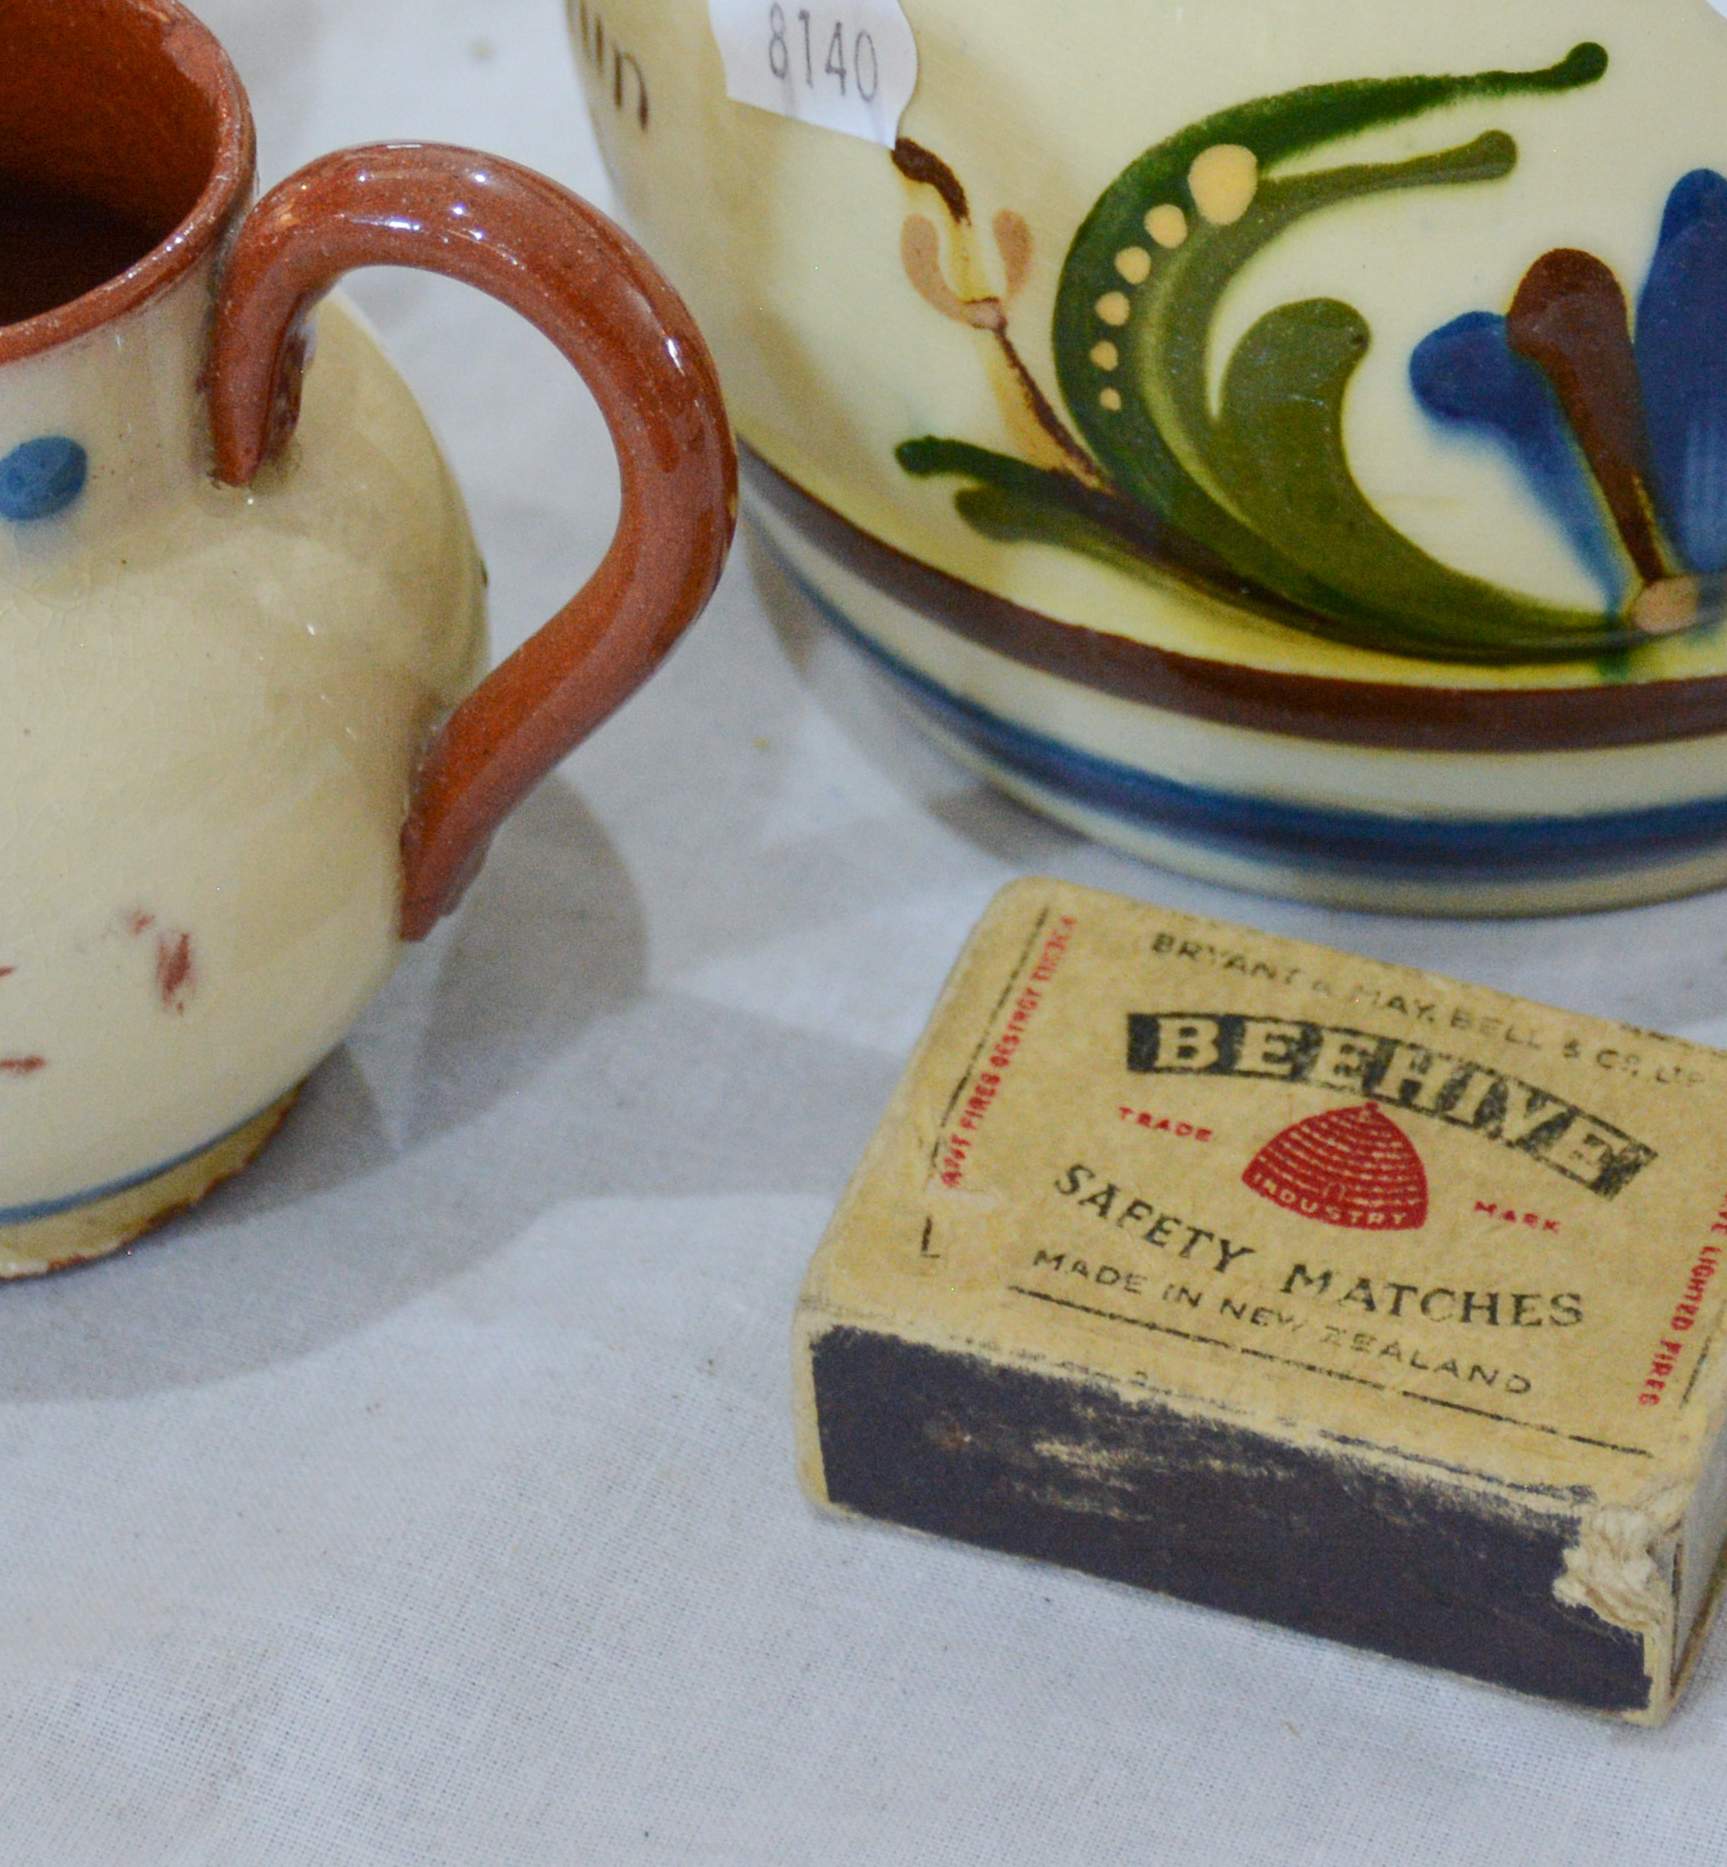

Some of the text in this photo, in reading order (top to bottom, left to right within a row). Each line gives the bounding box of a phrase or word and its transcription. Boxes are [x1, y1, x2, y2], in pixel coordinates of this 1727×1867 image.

[1450, 1008, 1541, 1052] BELL
[1150, 1014, 1624, 1194] BEEHIVE
[1117, 1106, 1562, 1233] TRADE MARK
[1252, 1173, 1408, 1227] INDUSTRY
[1053, 1163, 1586, 1328] SAFETY MATCHES
[1671, 1245, 1723, 1331] LIGHTED
[1033, 1249, 1534, 1397] MADE IN NEW ZEALAND
